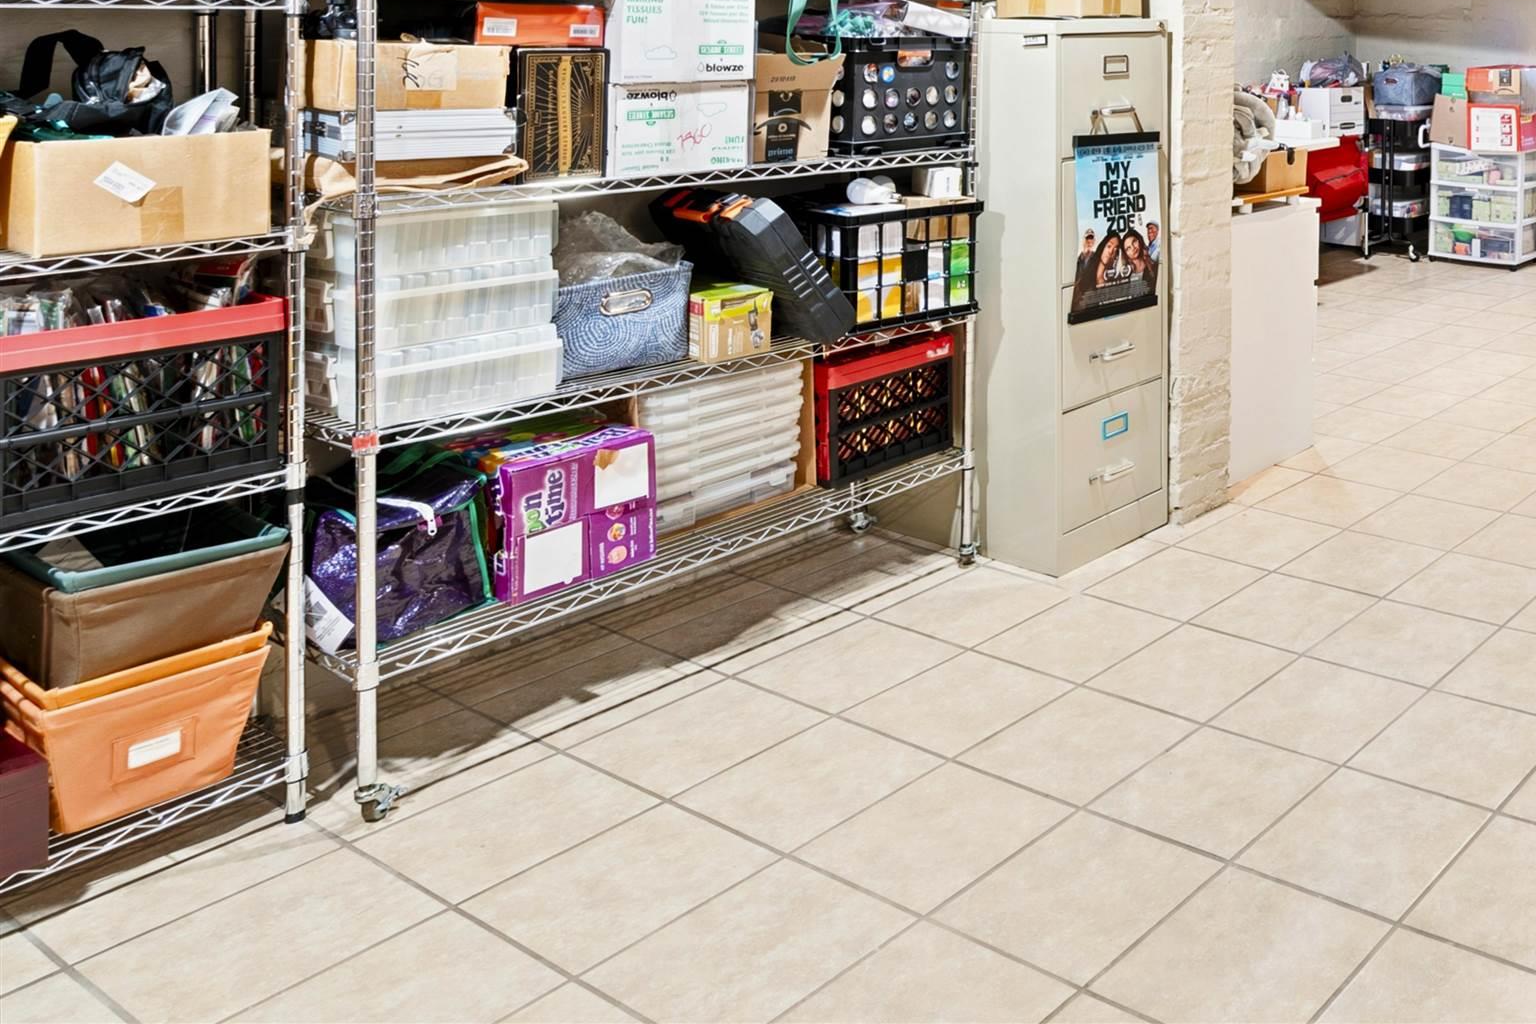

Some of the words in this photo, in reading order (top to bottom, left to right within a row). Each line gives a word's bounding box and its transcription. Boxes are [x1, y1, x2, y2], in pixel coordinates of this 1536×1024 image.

[627, 5, 663, 14] TISSUES
[626, 15, 648, 24] FUN!
[706, 62, 744, 73] blowze
[627, 91, 669, 101] blowze
[1105, 161, 1131, 180] MY
[1099, 177, 1140, 199] DEAD
[1094, 194, 1146, 218] FRIEND
[1106, 214, 1136, 235] ZOE
[545, 470, 564, 526] time
